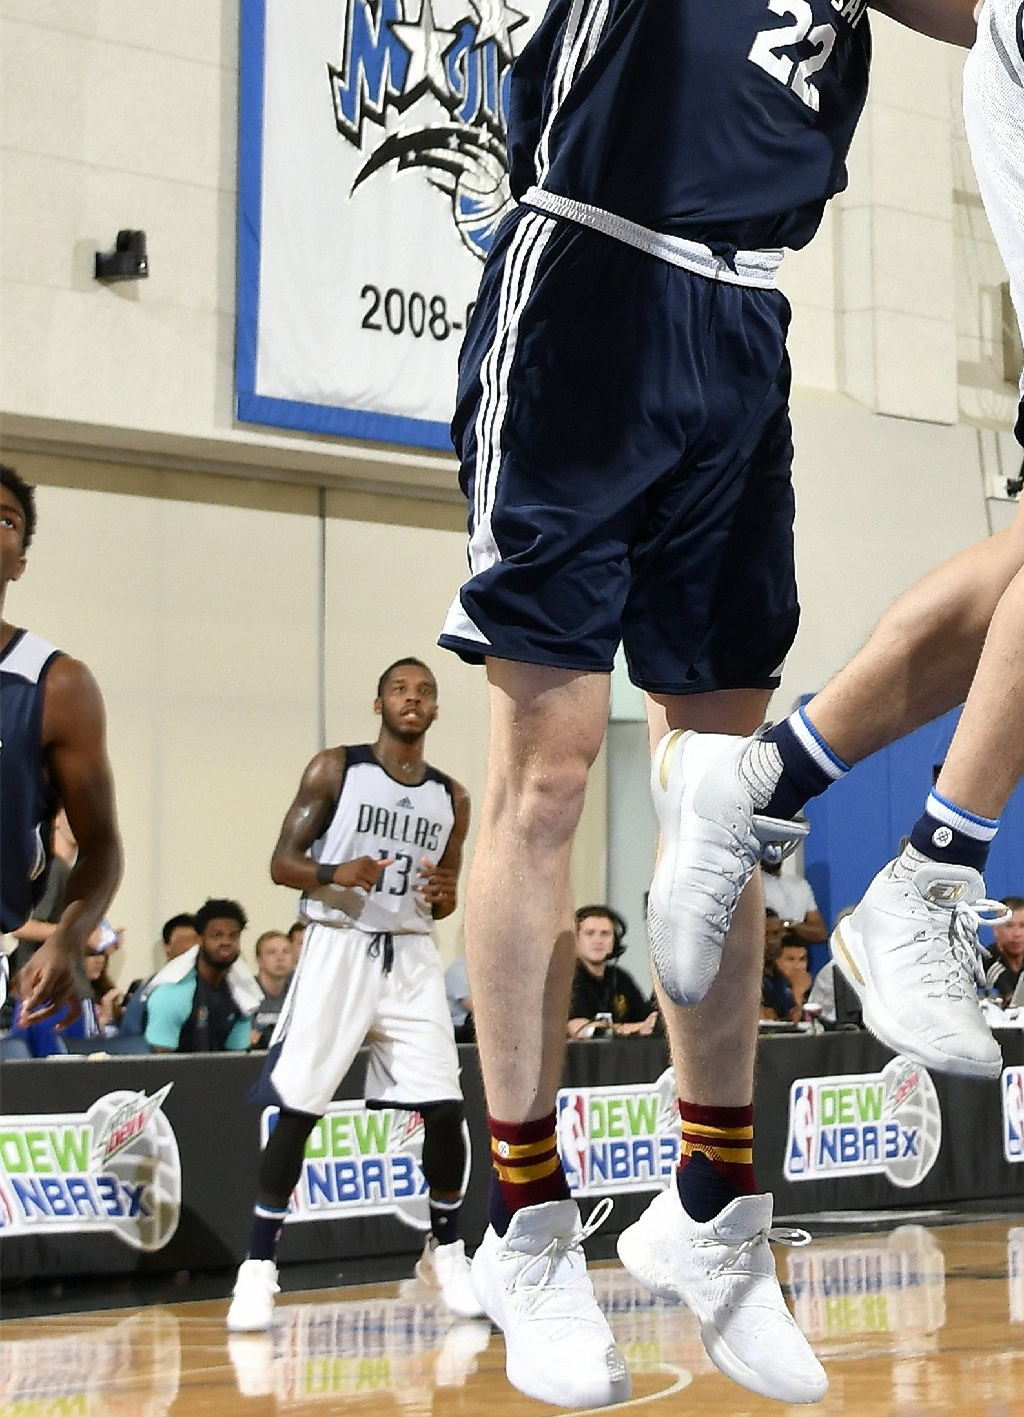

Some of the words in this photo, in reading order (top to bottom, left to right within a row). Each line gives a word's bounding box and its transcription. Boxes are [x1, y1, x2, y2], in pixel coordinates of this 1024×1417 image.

[360, 284, 476, 341] 2008-
[357, 804, 443, 851] DALLAS
[590, 1097, 659, 1140] DEW
[820, 1085, 883, 1126] DEW
[0, 1129, 92, 1173] DEW
[304, 1113, 391, 1159] DEW
